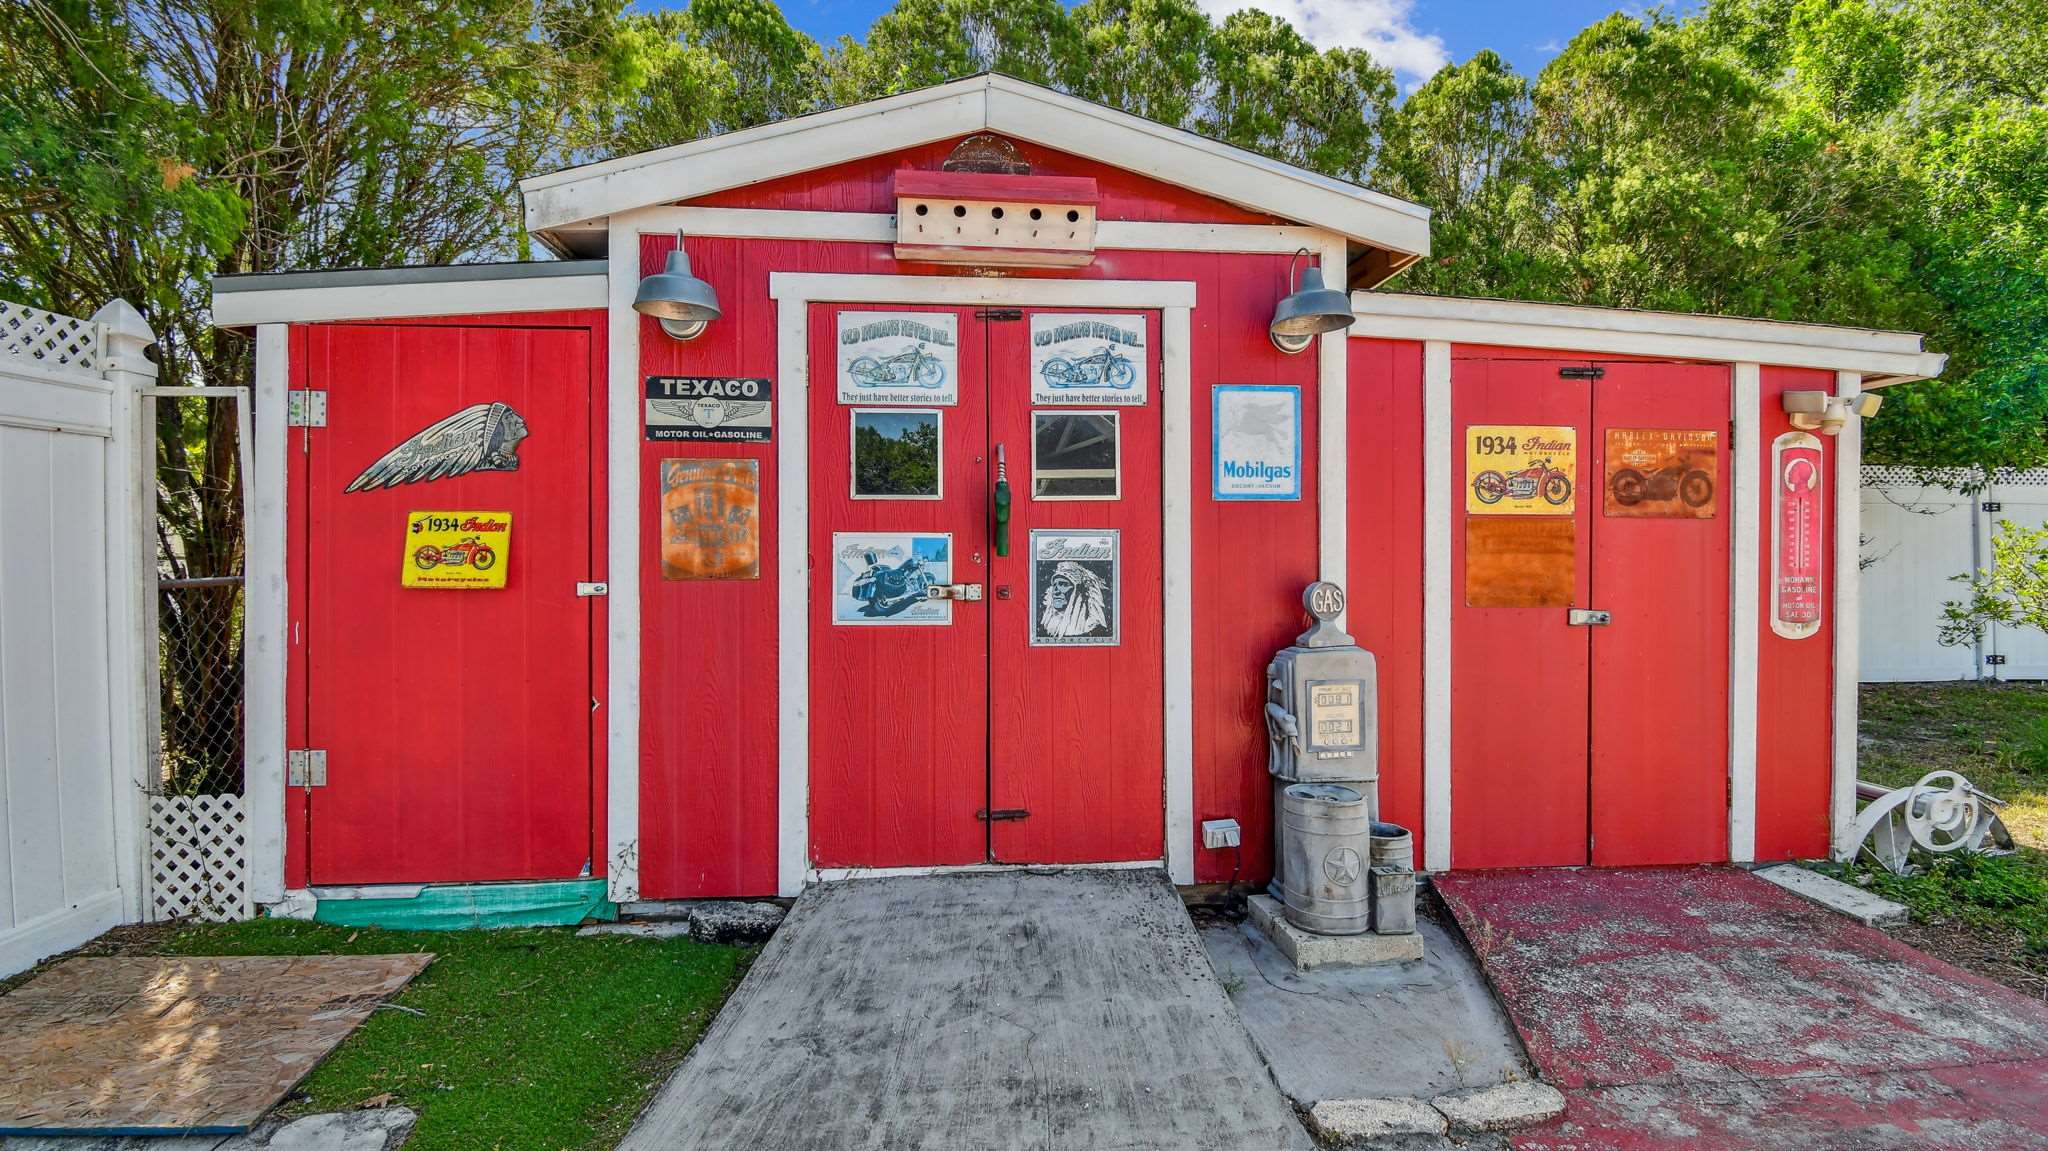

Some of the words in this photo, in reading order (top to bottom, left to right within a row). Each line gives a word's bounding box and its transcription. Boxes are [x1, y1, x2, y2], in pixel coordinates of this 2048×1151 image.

[841, 328, 860, 345] OLD
[861, 319, 900, 342] INDIANS
[901, 319, 931, 343] NEVER
[1034, 330, 1052, 346] OLD
[1053, 320, 1091, 343] INDIANS
[1092, 321, 1121, 344] NEVER
[660, 379, 759, 397] TEXACO
[842, 392, 858, 402] They
[858, 392, 872, 402] just
[873, 392, 889, 402] have
[889, 392, 909, 402] better
[909, 393, 932, 403] stories
[933, 393, 941, 402] to
[1036, 393, 1051, 403] They
[1051, 393, 1065, 403] just
[1065, 393, 1081, 403] have
[1081, 393, 1100, 403] better
[1101, 393, 1123, 403] stories
[1123, 394, 1131, 403] to
[656, 430, 690, 438] MOTOR
[1476, 436, 1517, 455] 1934
[1521, 436, 1571, 451] Indian
[1223, 461, 1291, 483] Mobilgas
[428, 518, 459, 532] 1934
[460, 516, 508, 533] Indian
[1040, 538, 1111, 560] Indian
[1312, 589, 1343, 613] GAS
